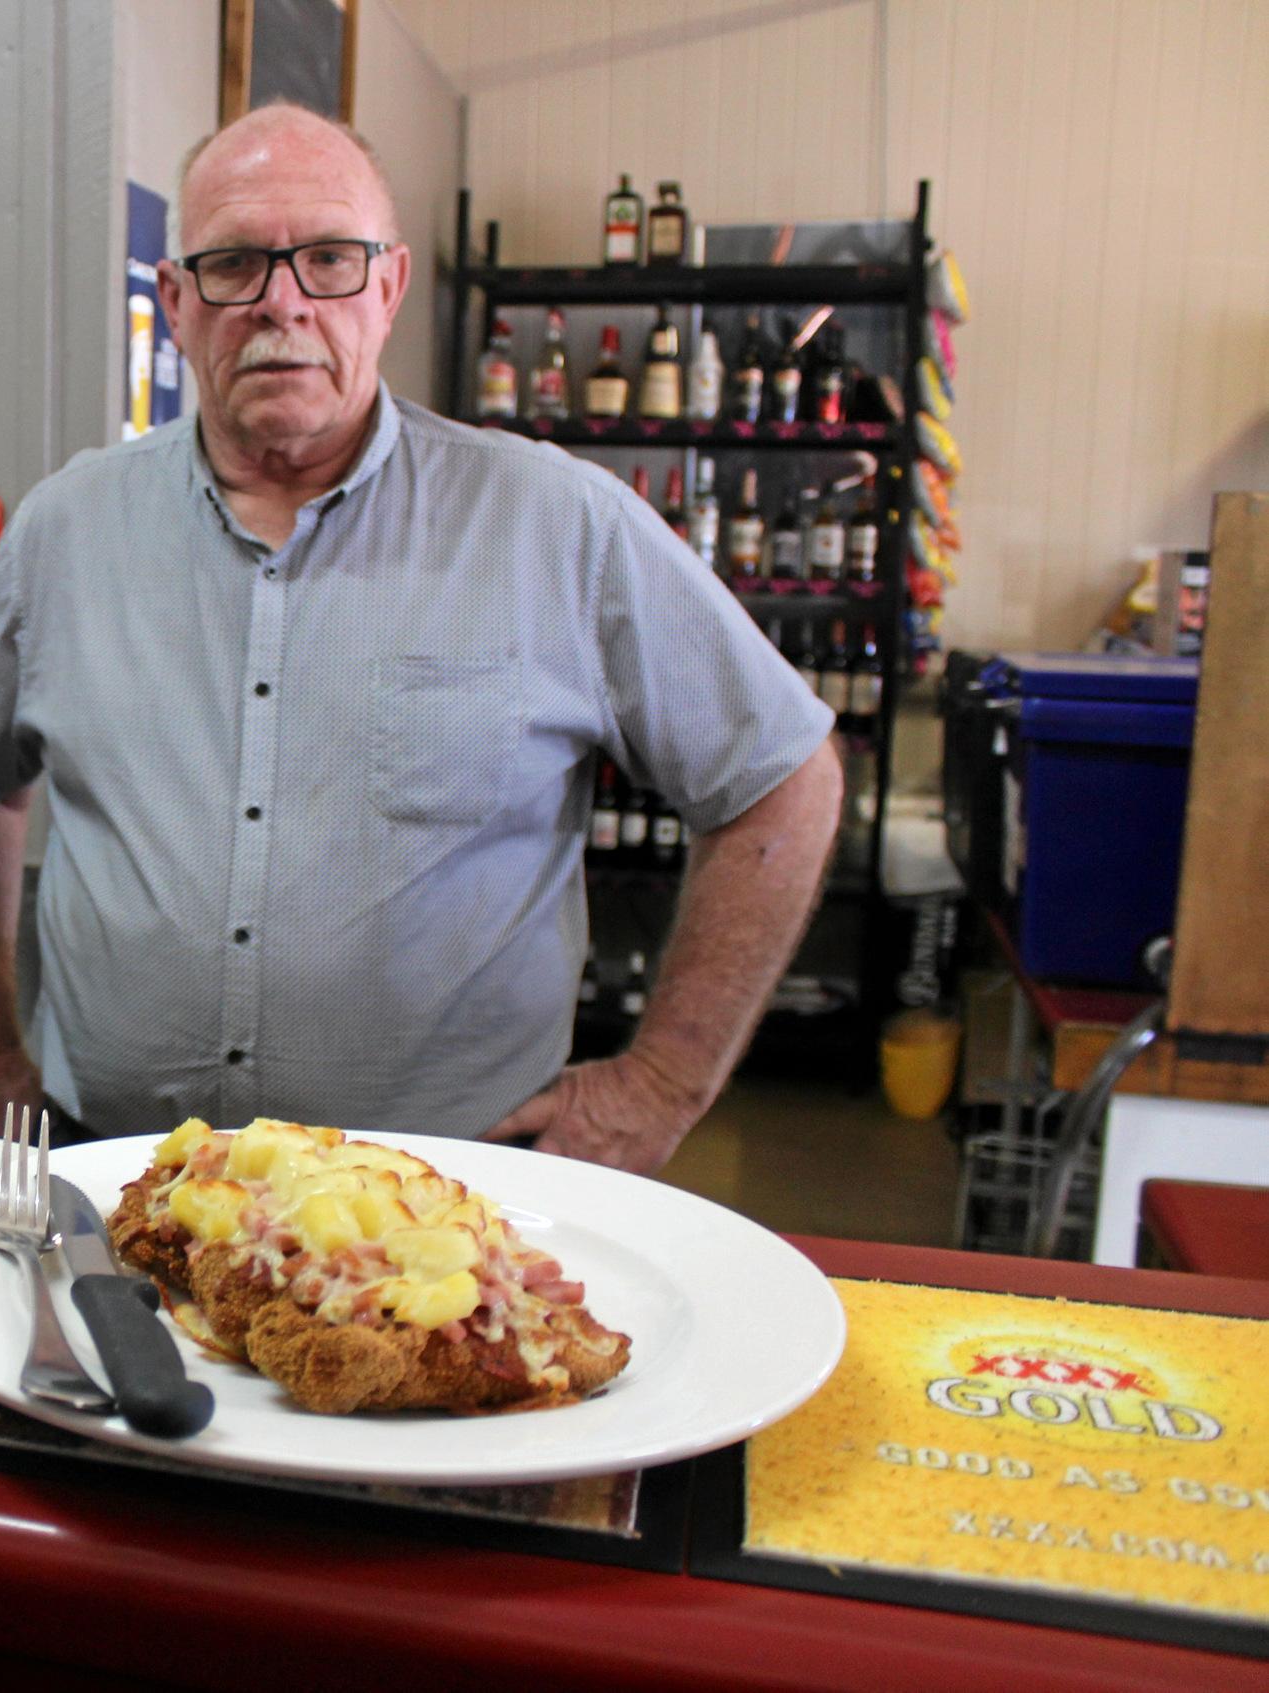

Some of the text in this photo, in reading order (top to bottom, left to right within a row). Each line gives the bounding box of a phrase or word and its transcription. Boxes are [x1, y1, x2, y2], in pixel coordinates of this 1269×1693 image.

[966, 1354, 1158, 1397] XXXX
[926, 1377, 1224, 1441] GOLD
[876, 1443, 1033, 1480] GOOD
[1061, 1464, 1141, 1494] AS
